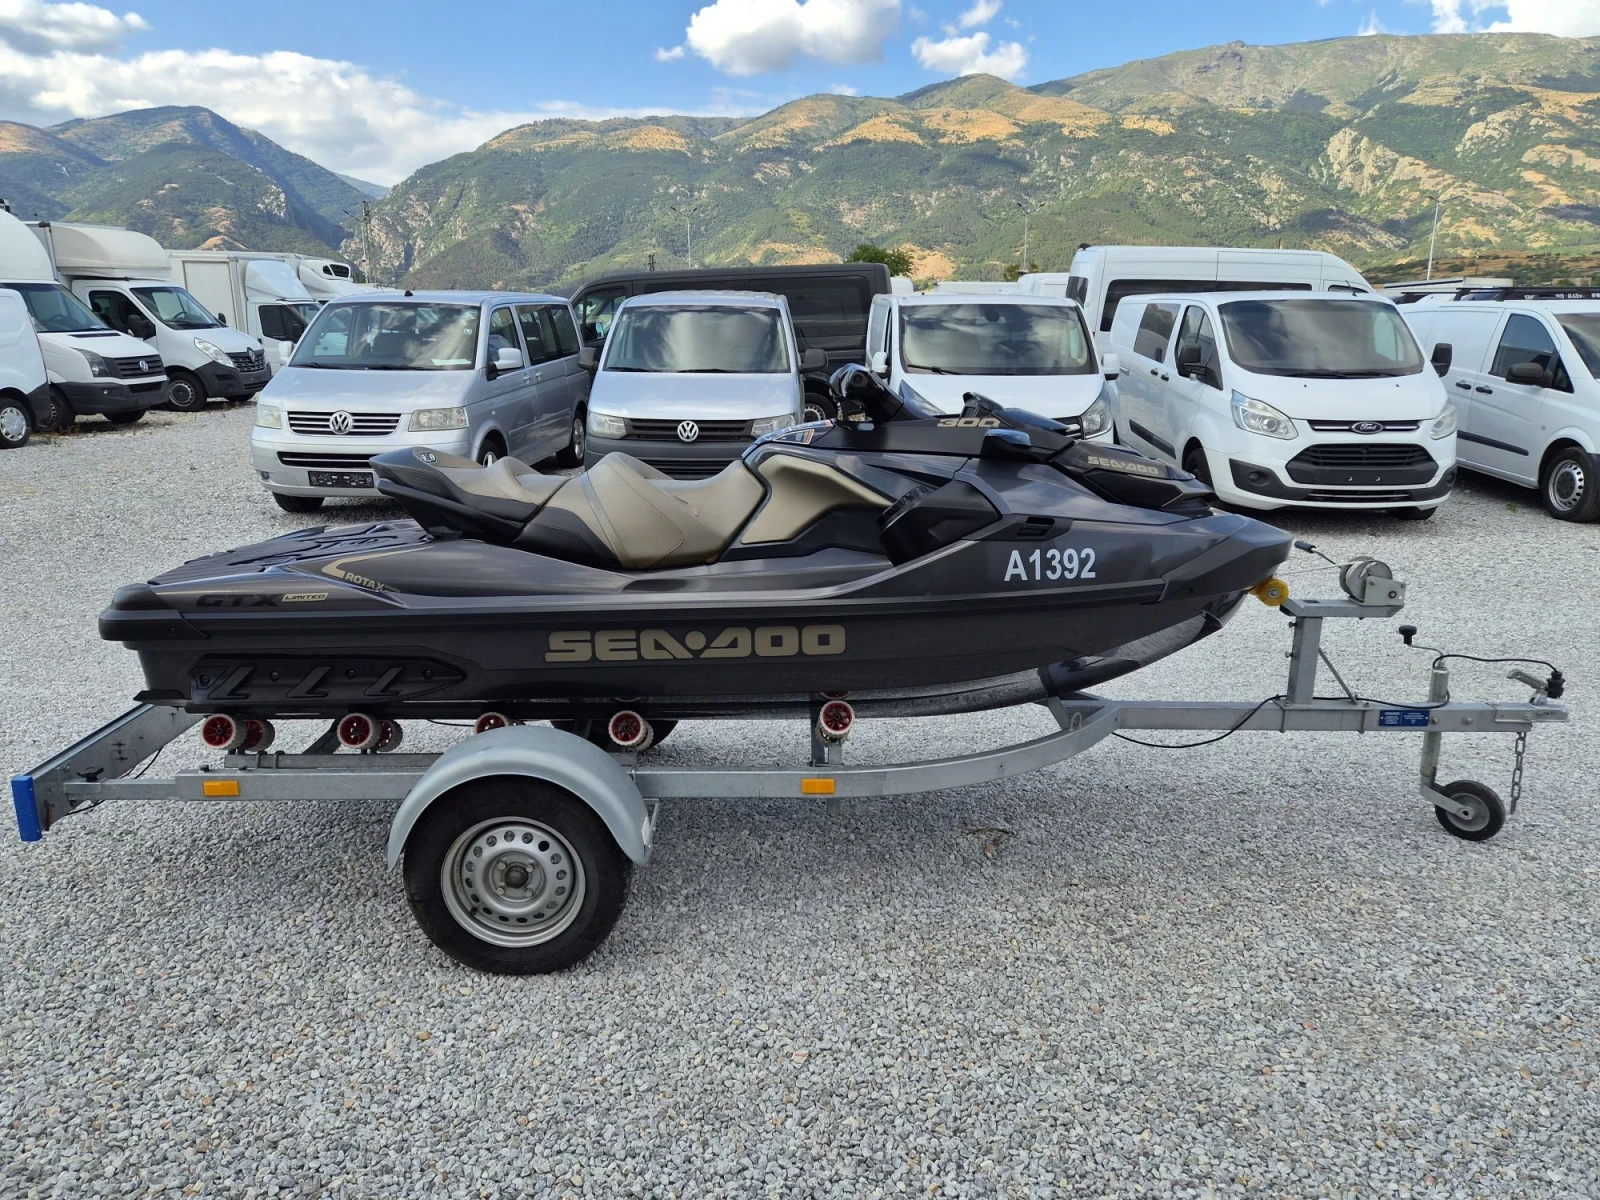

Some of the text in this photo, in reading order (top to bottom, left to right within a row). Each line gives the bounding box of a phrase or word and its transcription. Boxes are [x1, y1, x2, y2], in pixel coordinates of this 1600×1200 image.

[937, 417, 1001, 428] 300
[1003, 547, 1097, 582] A1392
[345, 572, 385, 592] ROTAX
[195, 593, 327, 608] GTX LIMITED
